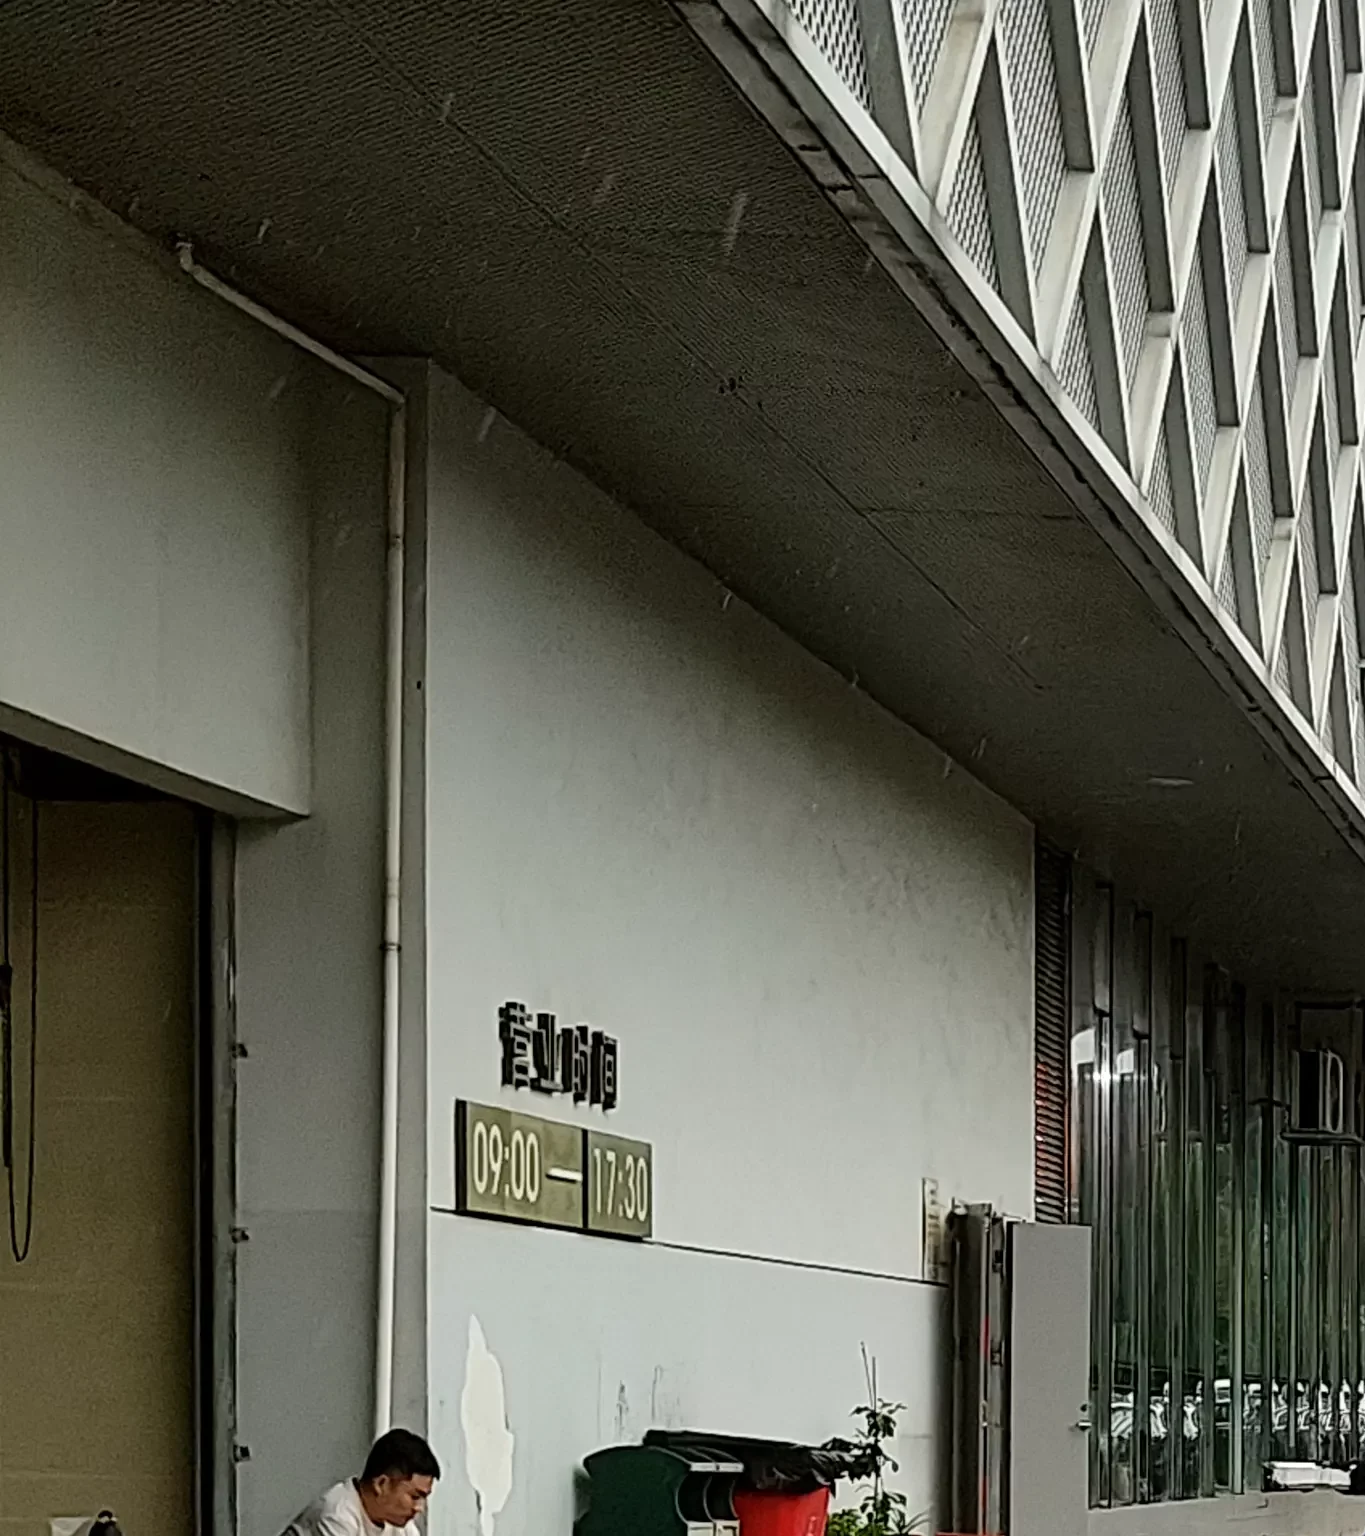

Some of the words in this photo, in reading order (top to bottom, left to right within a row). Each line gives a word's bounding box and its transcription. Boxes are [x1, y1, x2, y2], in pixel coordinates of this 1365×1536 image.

[498, 1002, 618, 1111] 营业时间
[473, 1121, 541, 1203] 09:00
[593, 1148, 649, 1222] 17:30
